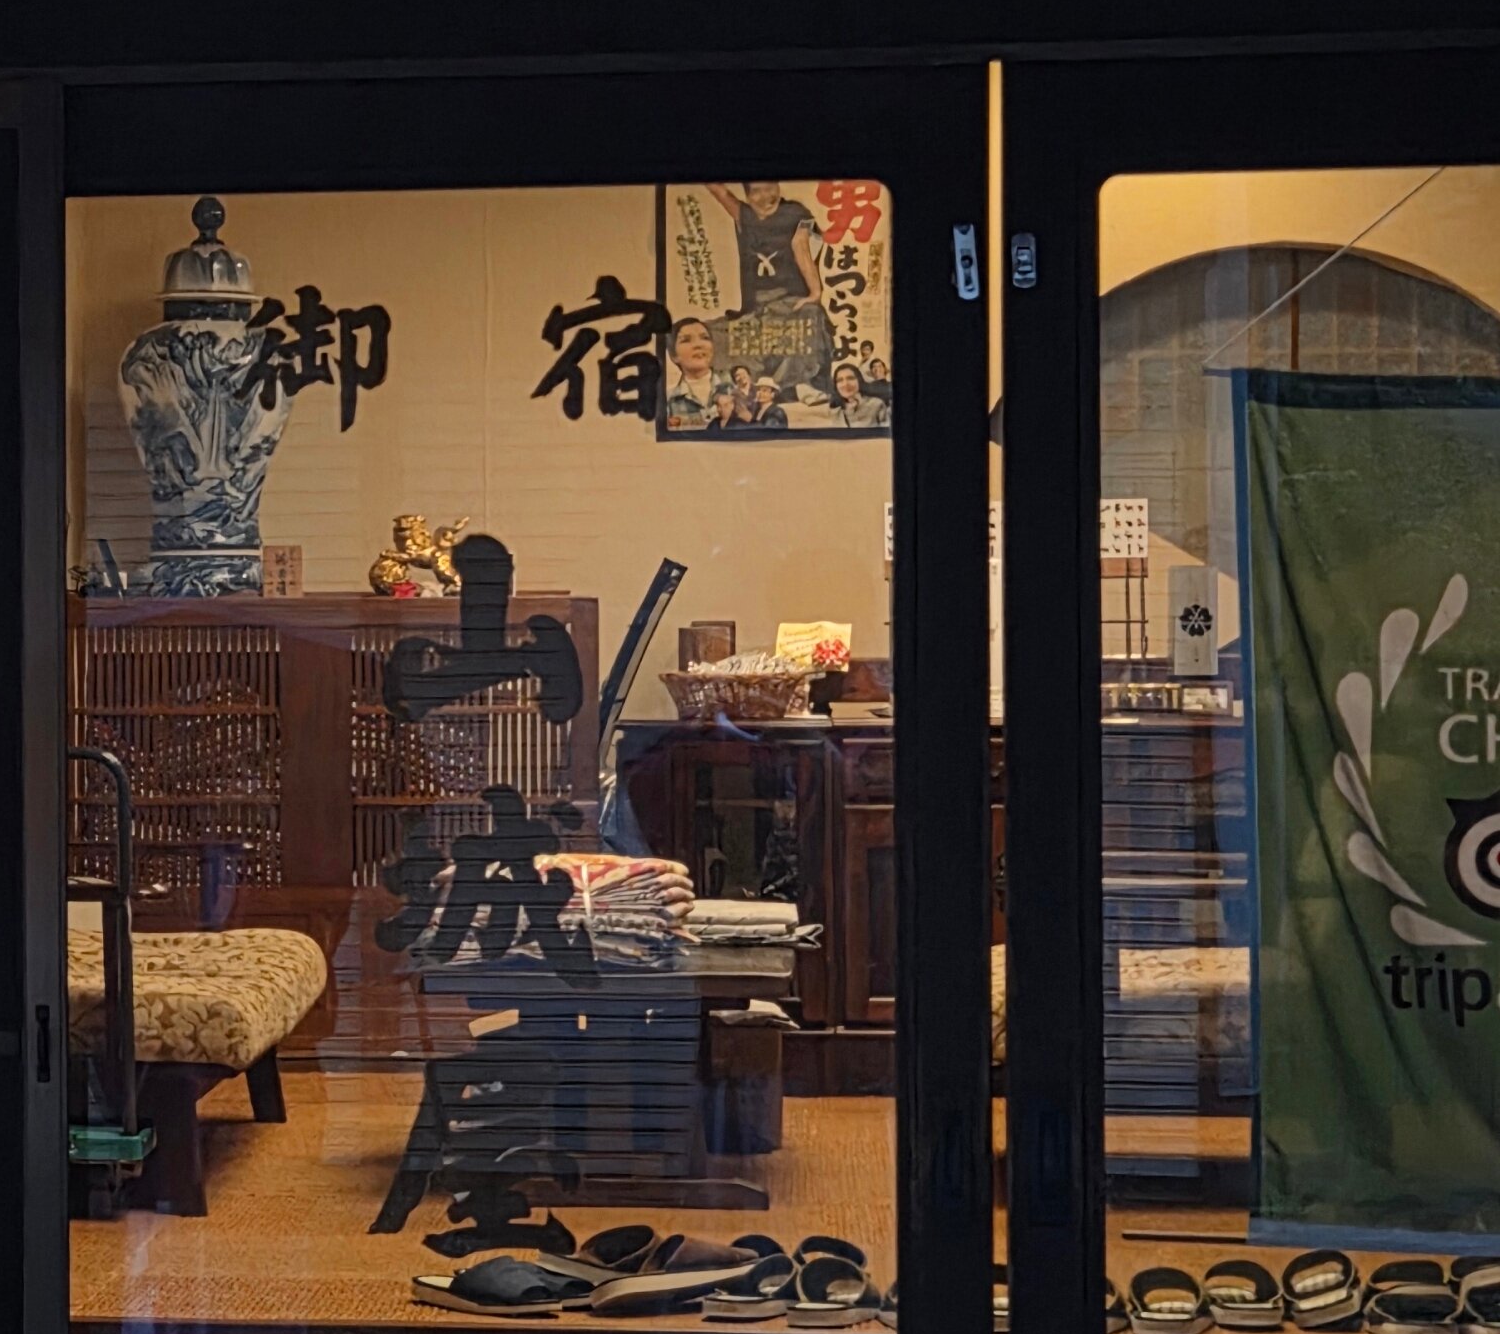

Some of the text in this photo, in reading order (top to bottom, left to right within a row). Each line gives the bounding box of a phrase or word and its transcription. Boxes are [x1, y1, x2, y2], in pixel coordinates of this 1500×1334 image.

[1438, 667, 1500, 701] TR
[367, 533, 600, 1257] 山城屋
